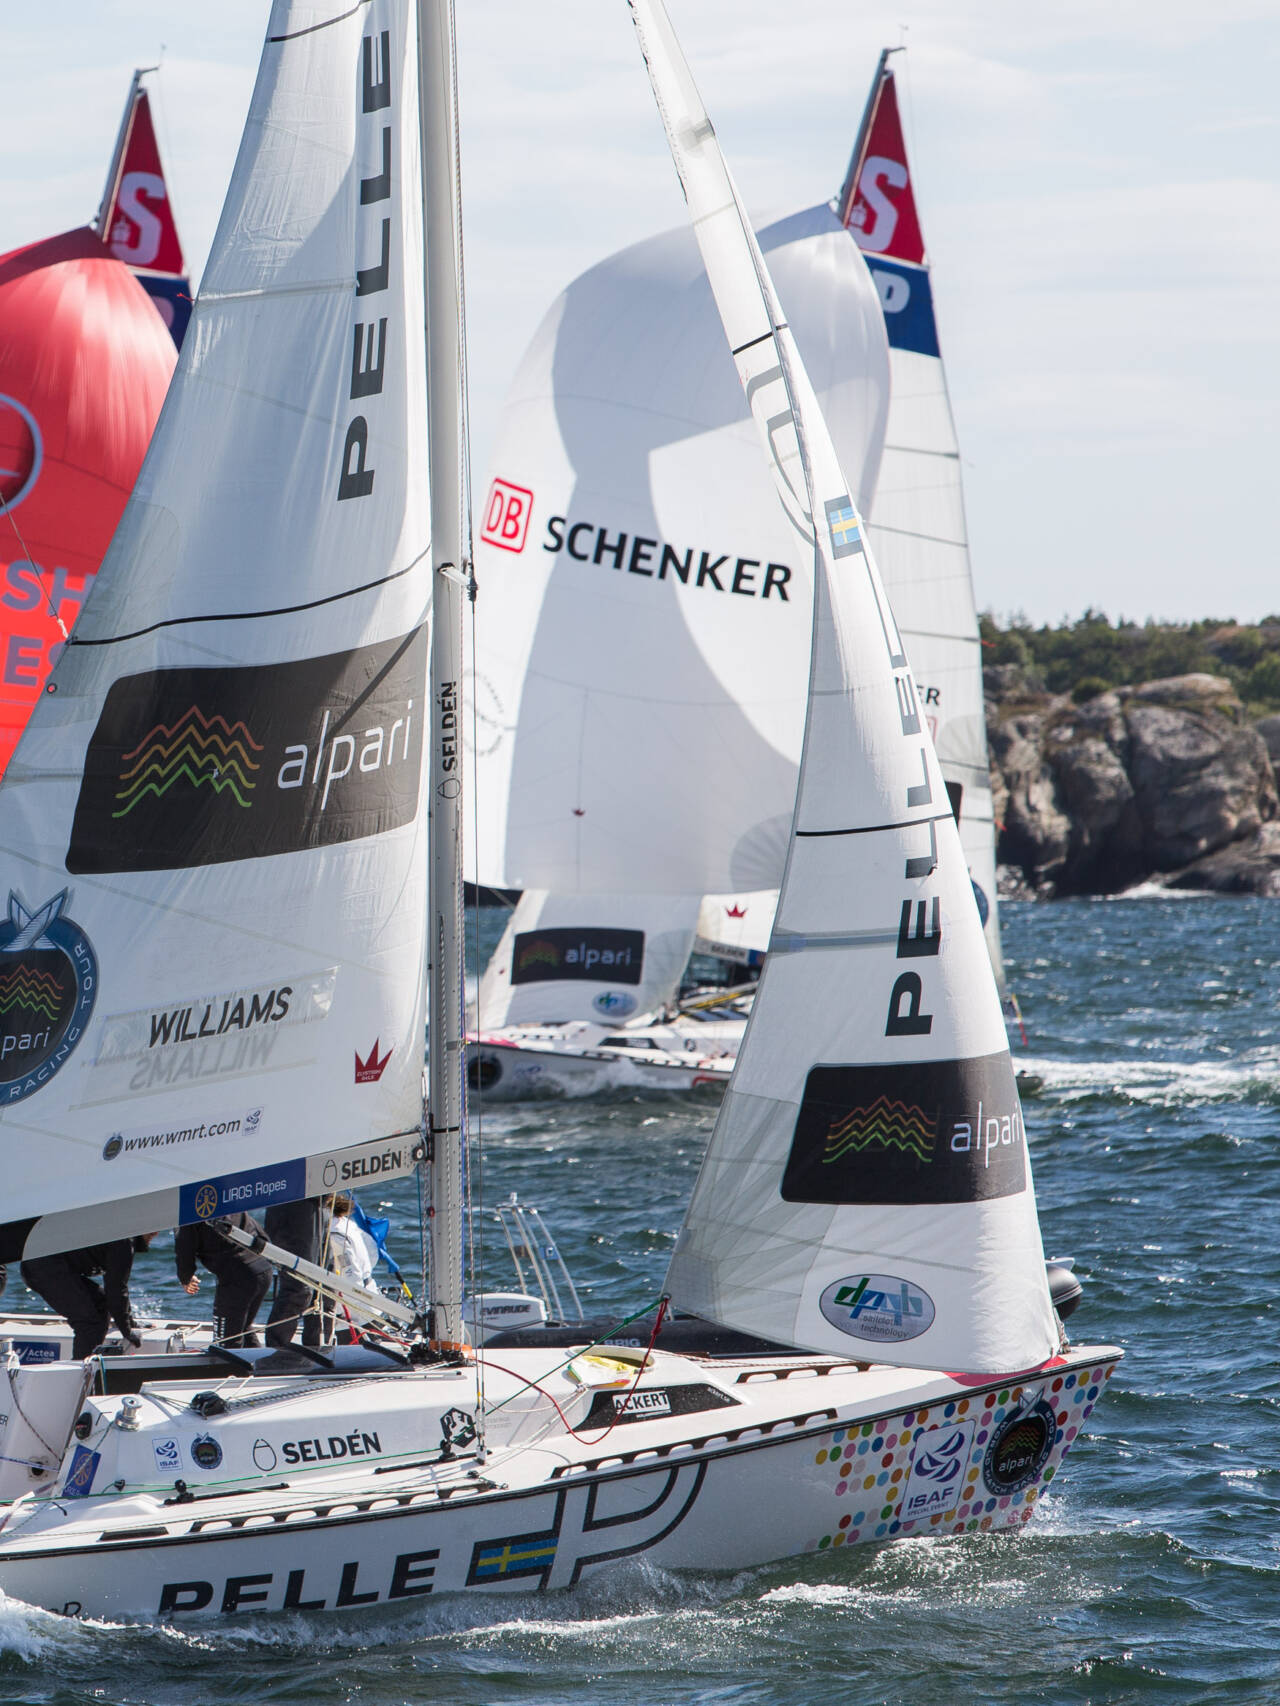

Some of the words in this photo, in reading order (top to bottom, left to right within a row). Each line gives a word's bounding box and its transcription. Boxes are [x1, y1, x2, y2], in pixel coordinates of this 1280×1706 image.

[337, 30, 392, 502] PELLE
[491, 487, 525, 541] DB
[542, 514, 793, 603] SCHENKER
[436, 681, 458, 772] SELDÉN
[278, 700, 412, 811] alpari
[885, 674, 941, 1037] PELLE
[565, 942, 631, 971] alpari
[9, 1027, 80, 1099] RACING
[74, 943, 93, 1010] TOUR
[148, 986, 293, 1048] WILLIAMS
[124, 1117, 241, 1153] www.wmrt.com
[341, 1149, 403, 1182] SELDÉN
[222, 1183, 252, 1203] LIROS
[256, 1179, 287, 1197] Ropes
[480, 1304, 531, 1316] EVINRUDE
[27, 1348, 55, 1358] Actea
[604, 1338, 642, 1348] BRIG
[615, 1391, 668, 1412] ACKERT
[284, 1428, 382, 1464] SELDÉN
[998, 1453, 1035, 1472] alpari
[907, 1487, 954, 1510] ISAF
[158, 1548, 440, 1614] PELLE
